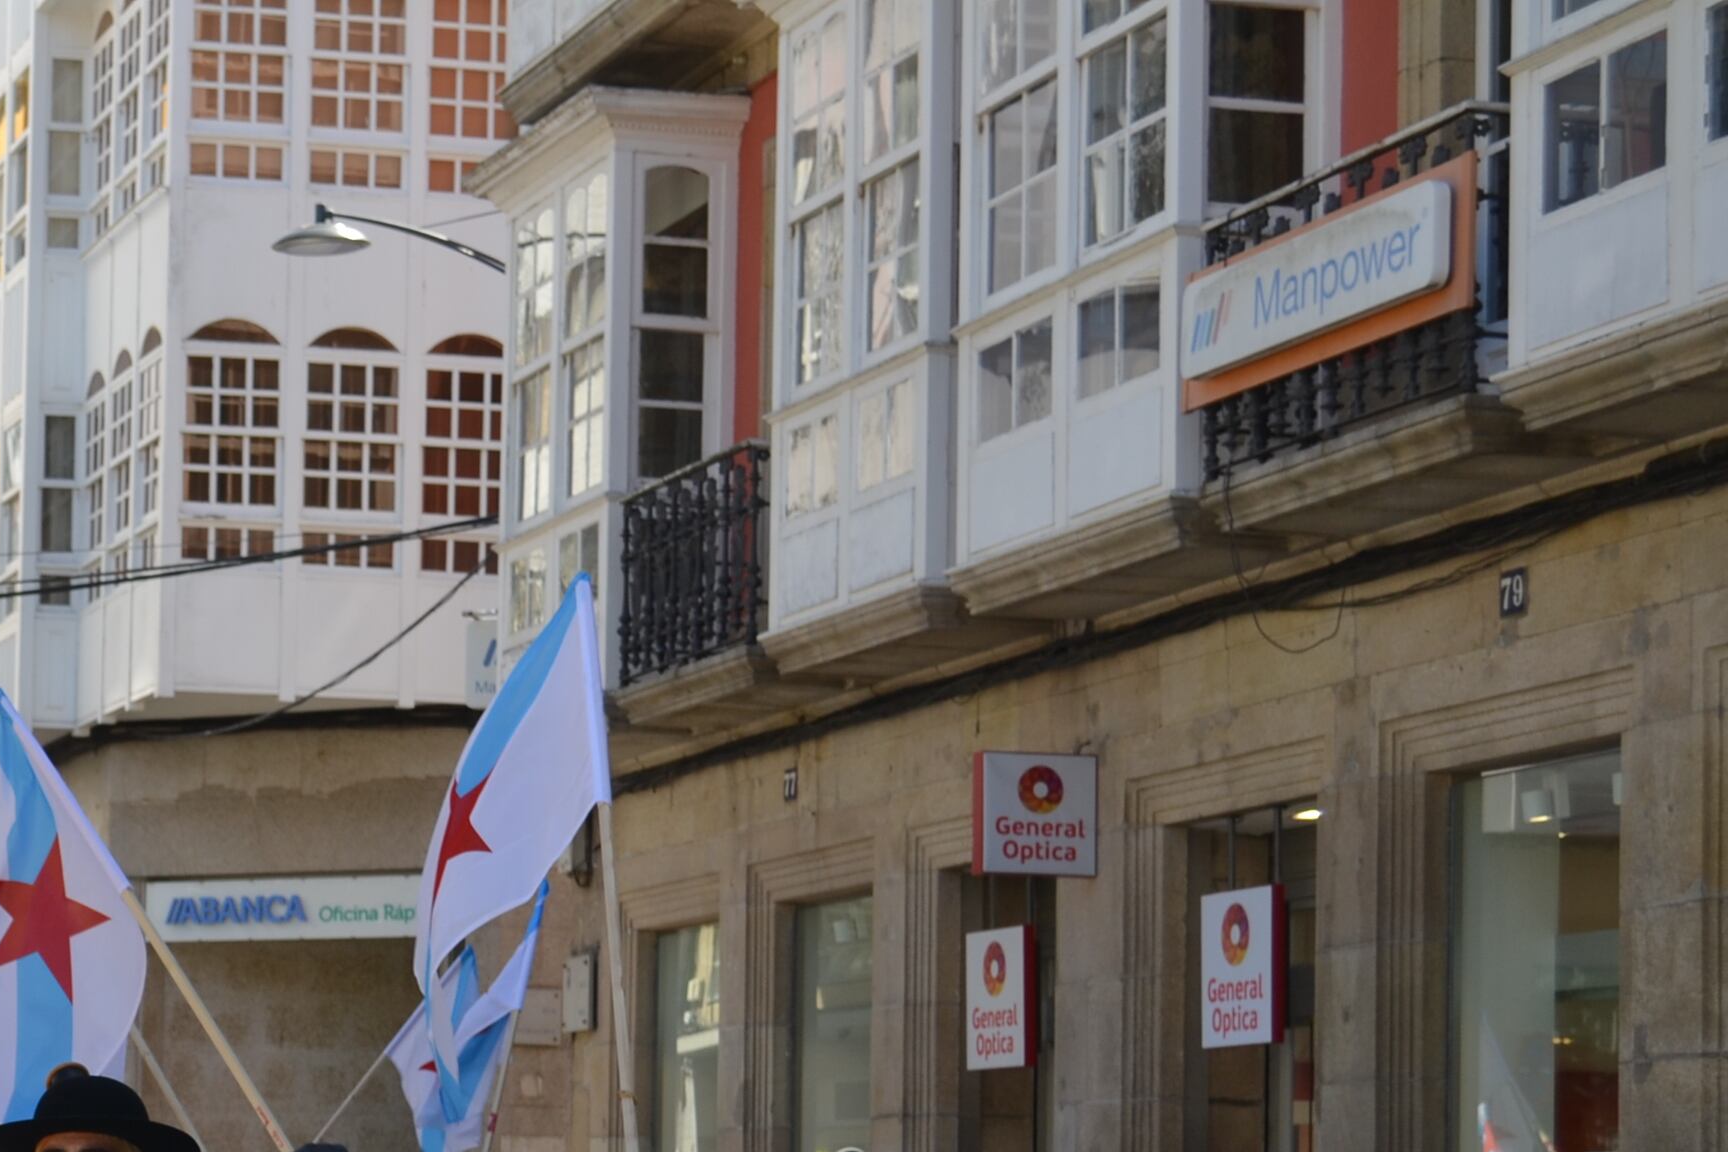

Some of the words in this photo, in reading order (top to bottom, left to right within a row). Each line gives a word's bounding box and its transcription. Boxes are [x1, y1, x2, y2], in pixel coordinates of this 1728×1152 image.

[1254, 223, 1420, 329] Manpower
[1501, 574, 1523, 610] 79
[995, 816, 1085, 839] General
[1002, 840, 1077, 864] Optica
[167, 895, 307, 925] ABANCA
[318, 905, 378, 923] Oficina
[1208, 972, 1263, 1003] General
[972, 1003, 1018, 1031] General
[1212, 1005, 1258, 1039] Optica
[976, 1032, 1014, 1060] Optica
